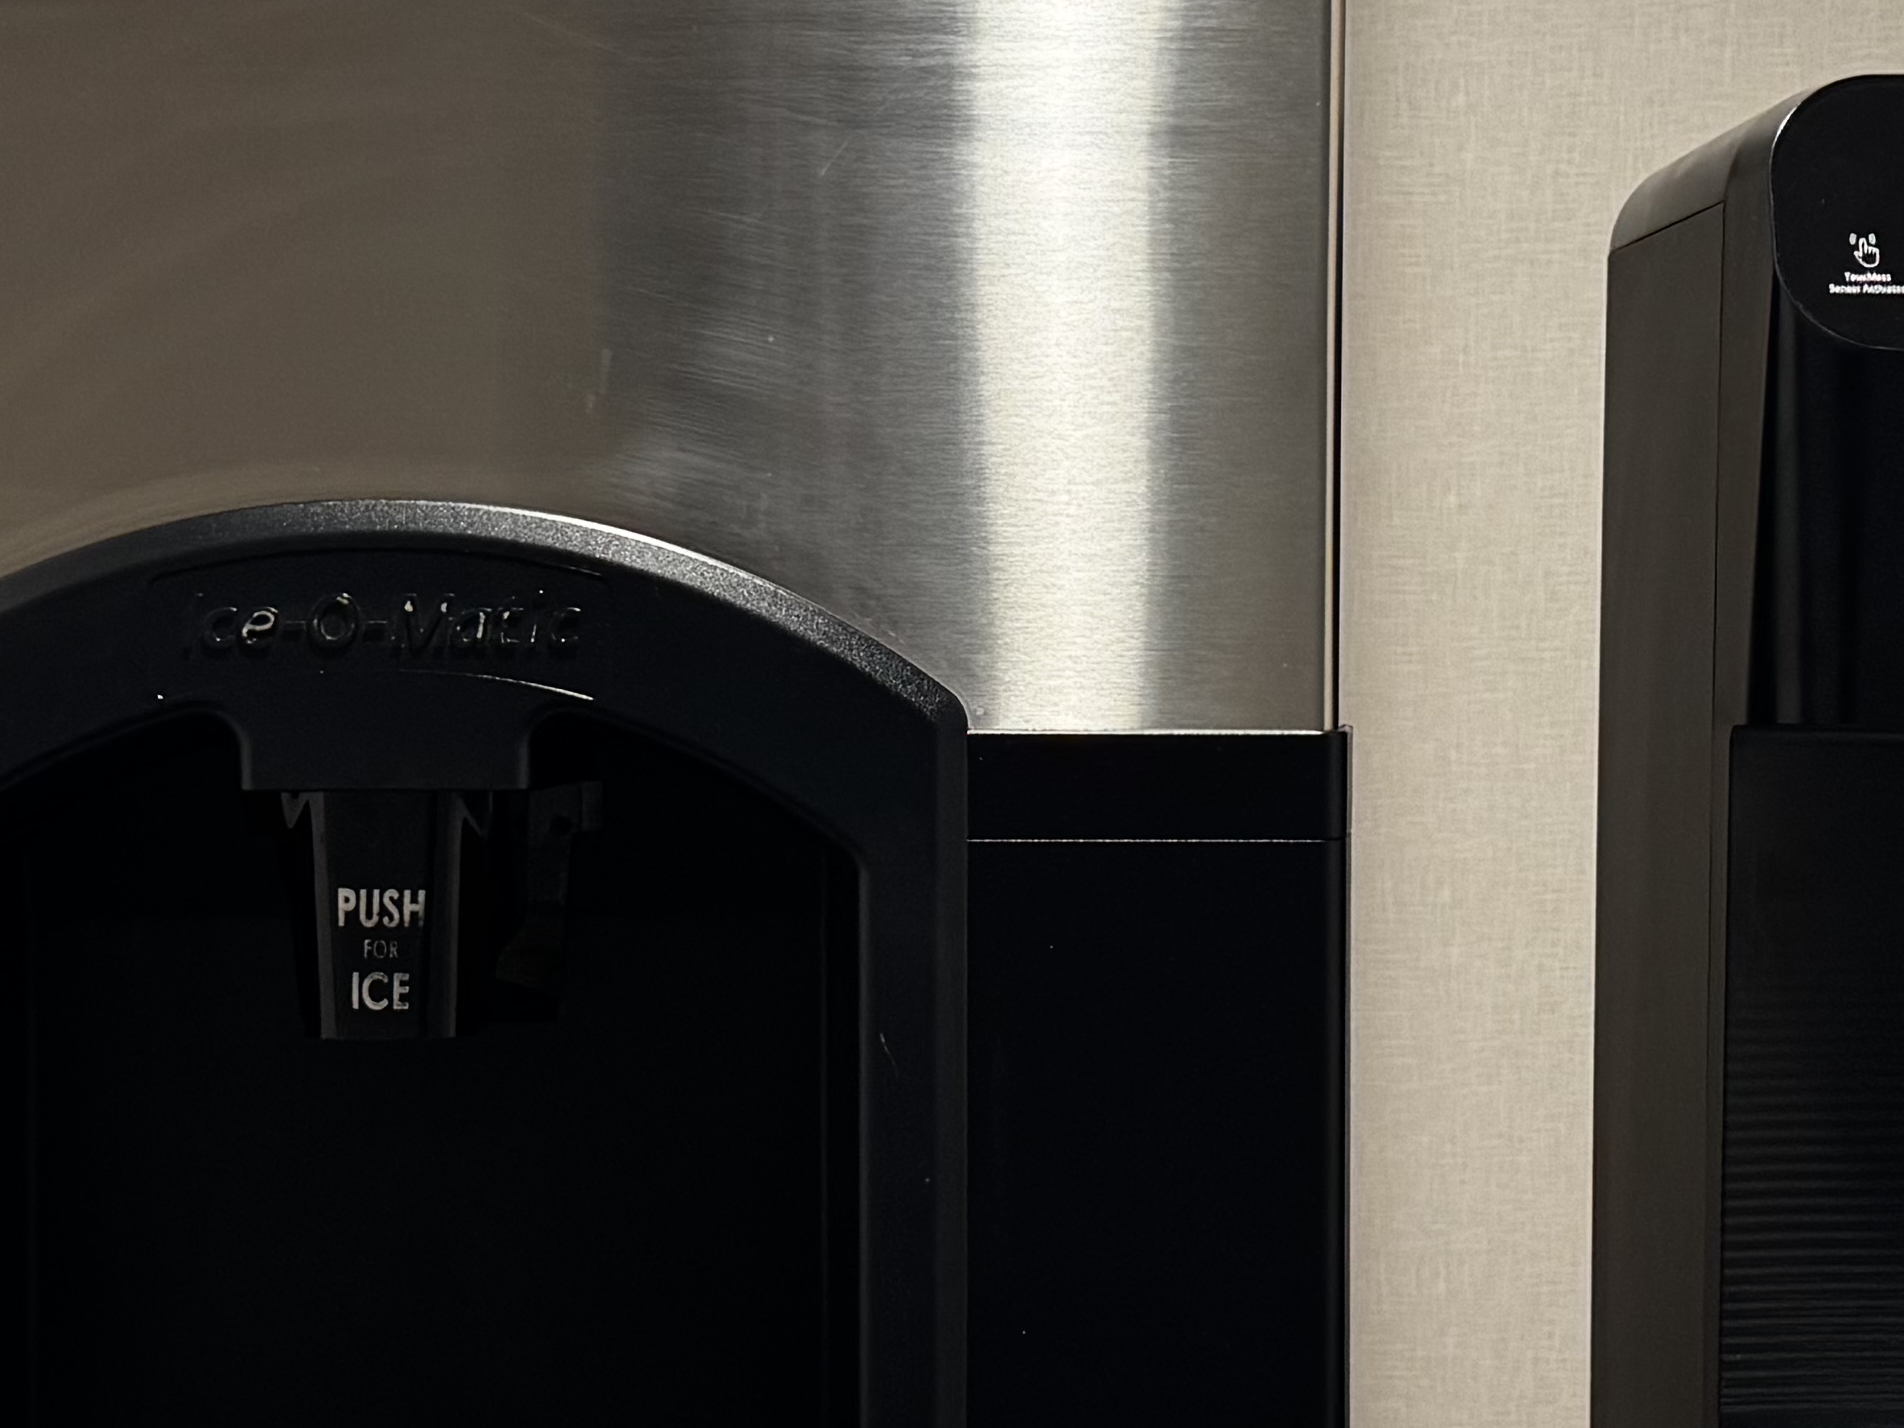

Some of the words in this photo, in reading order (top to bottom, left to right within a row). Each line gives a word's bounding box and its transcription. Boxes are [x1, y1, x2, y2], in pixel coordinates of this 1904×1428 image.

[186, 589, 585, 654] ce-O-Matic
[337, 887, 426, 928] PUSH
[363, 939, 399, 959] FOR
[351, 971, 410, 1011] ICE
